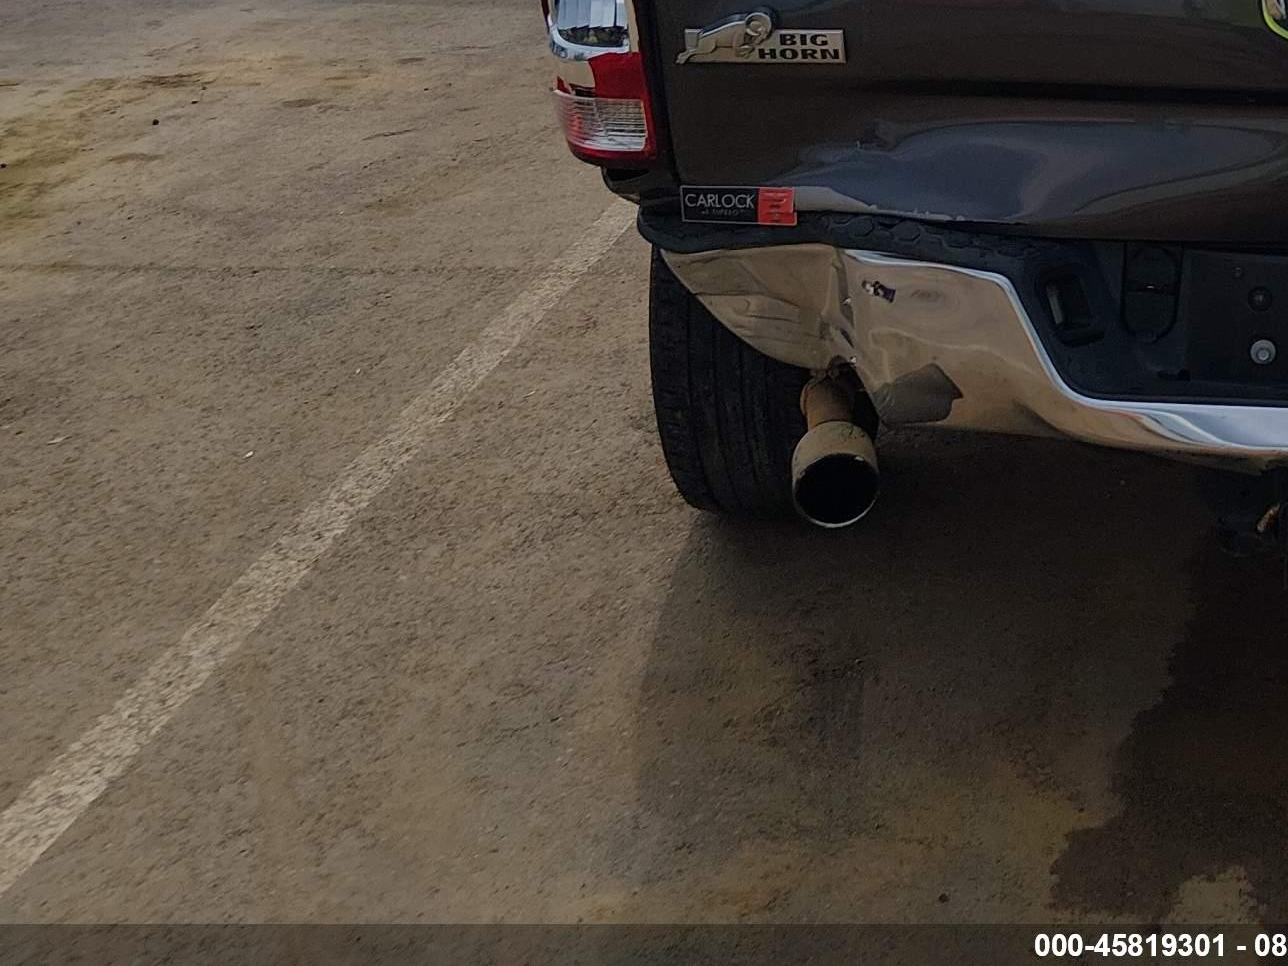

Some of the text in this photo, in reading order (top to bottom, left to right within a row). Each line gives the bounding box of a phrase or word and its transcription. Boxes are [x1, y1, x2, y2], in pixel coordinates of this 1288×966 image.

[779, 33, 829, 46] BIG
[758, 47, 840, 60] HORN
[684, 193, 755, 209] CARLOCK
